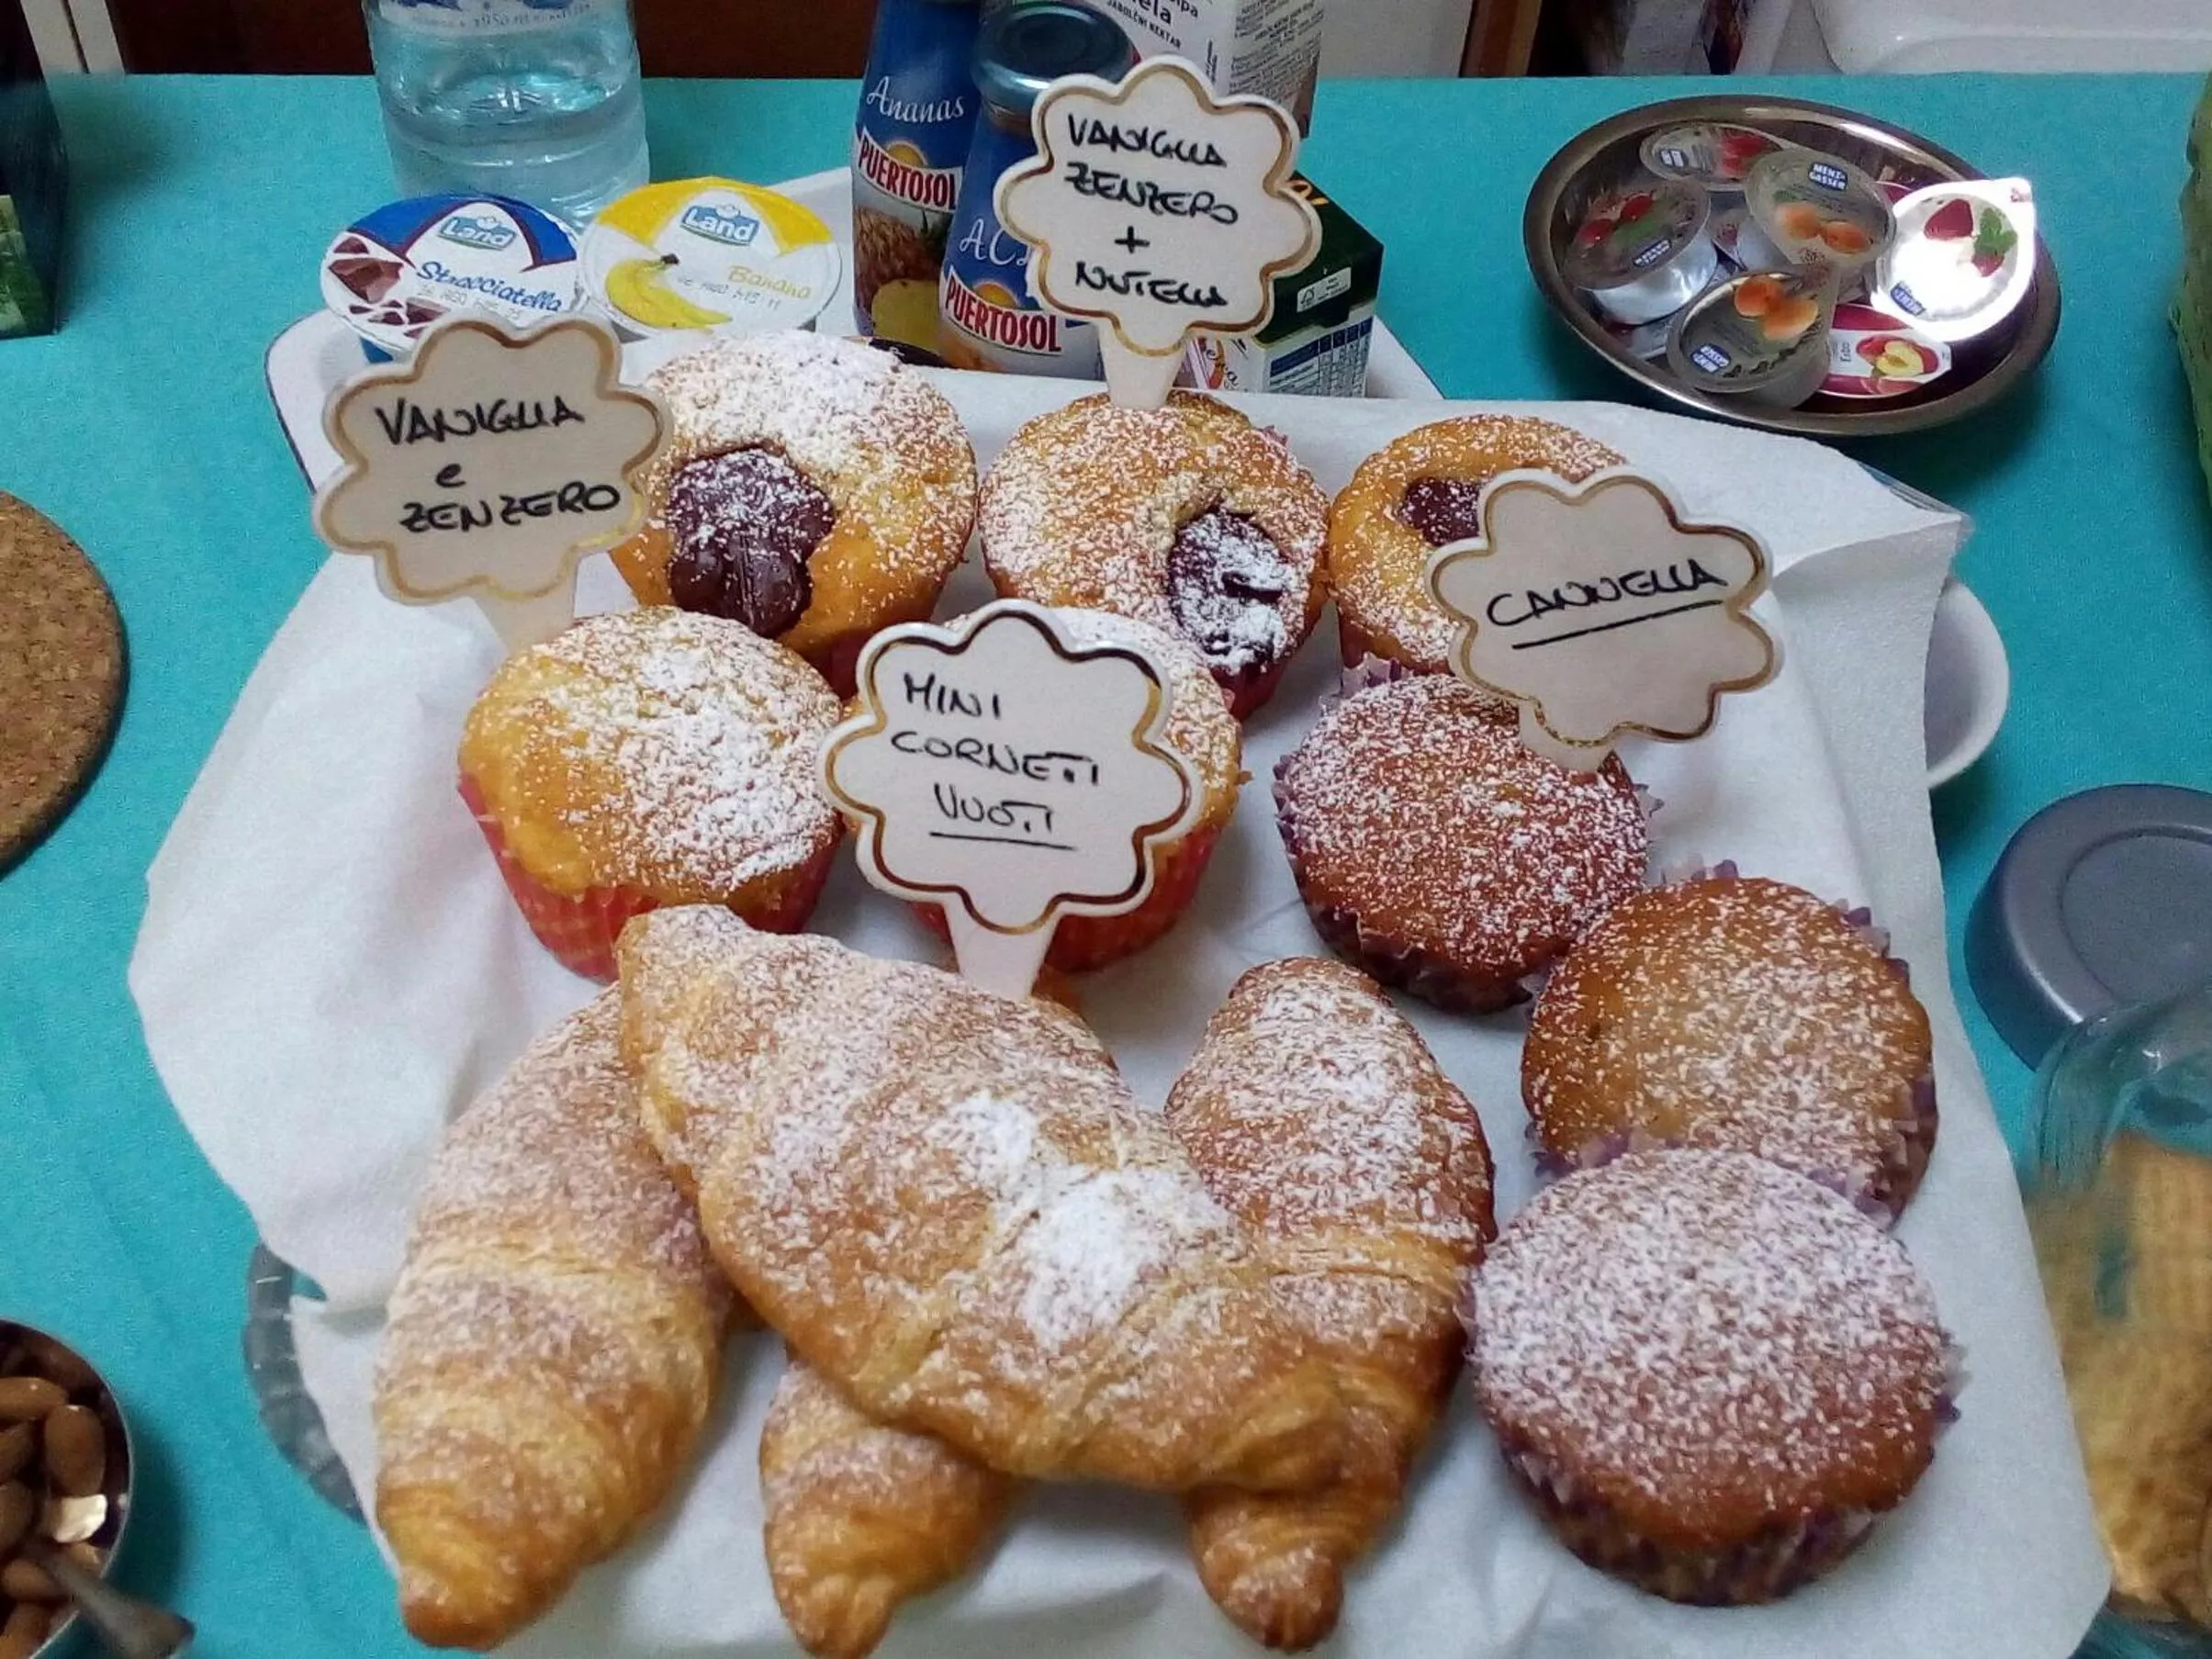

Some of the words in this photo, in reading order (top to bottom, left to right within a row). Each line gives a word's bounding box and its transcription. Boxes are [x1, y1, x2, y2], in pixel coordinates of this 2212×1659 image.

[1130, 0, 1172, 25] ela
[1149, 23, 1181, 50] NEKTAR
[866, 76, 965, 122] Ananas
[1068, 114, 1227, 167] VANIGLIA
[859, 144, 957, 210] PUERTOSOL
[1065, 162, 1238, 224] ZENZERO
[443, 219, 514, 248] Land
[685, 207, 756, 242] Land
[1115, 226, 1150, 253] +
[416, 261, 562, 311] Stracciatella
[728, 265, 813, 298] Banana
[1076, 262, 1228, 307] NUTELLA
[945, 278, 1061, 352] PUERTOSOL
[375, 396, 585, 445] VANIGLIA
[399, 482, 620, 532] ZENZERO
[1487, 558, 1727, 625] CANNELLA
[904, 672, 1000, 719] MINI
[891, 732, 1098, 786] CORNETTI
[934, 783, 1053, 832] VUOTI
